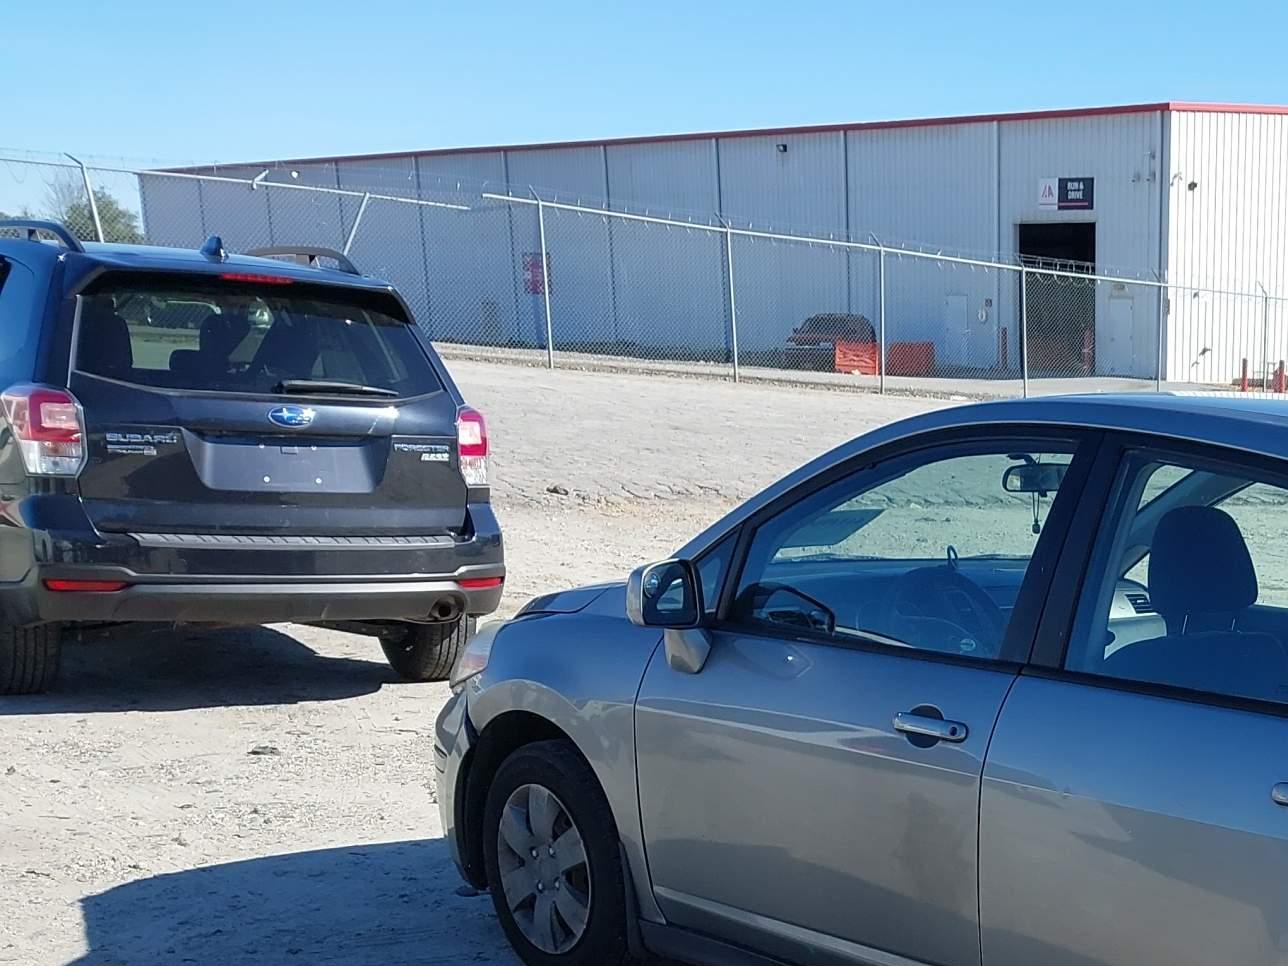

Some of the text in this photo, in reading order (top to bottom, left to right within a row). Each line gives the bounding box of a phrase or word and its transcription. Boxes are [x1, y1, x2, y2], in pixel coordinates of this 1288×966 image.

[1067, 181, 1079, 190] RUN
[1067, 190, 1083, 200] DRIVE
[105, 432, 178, 444] SUBARU
